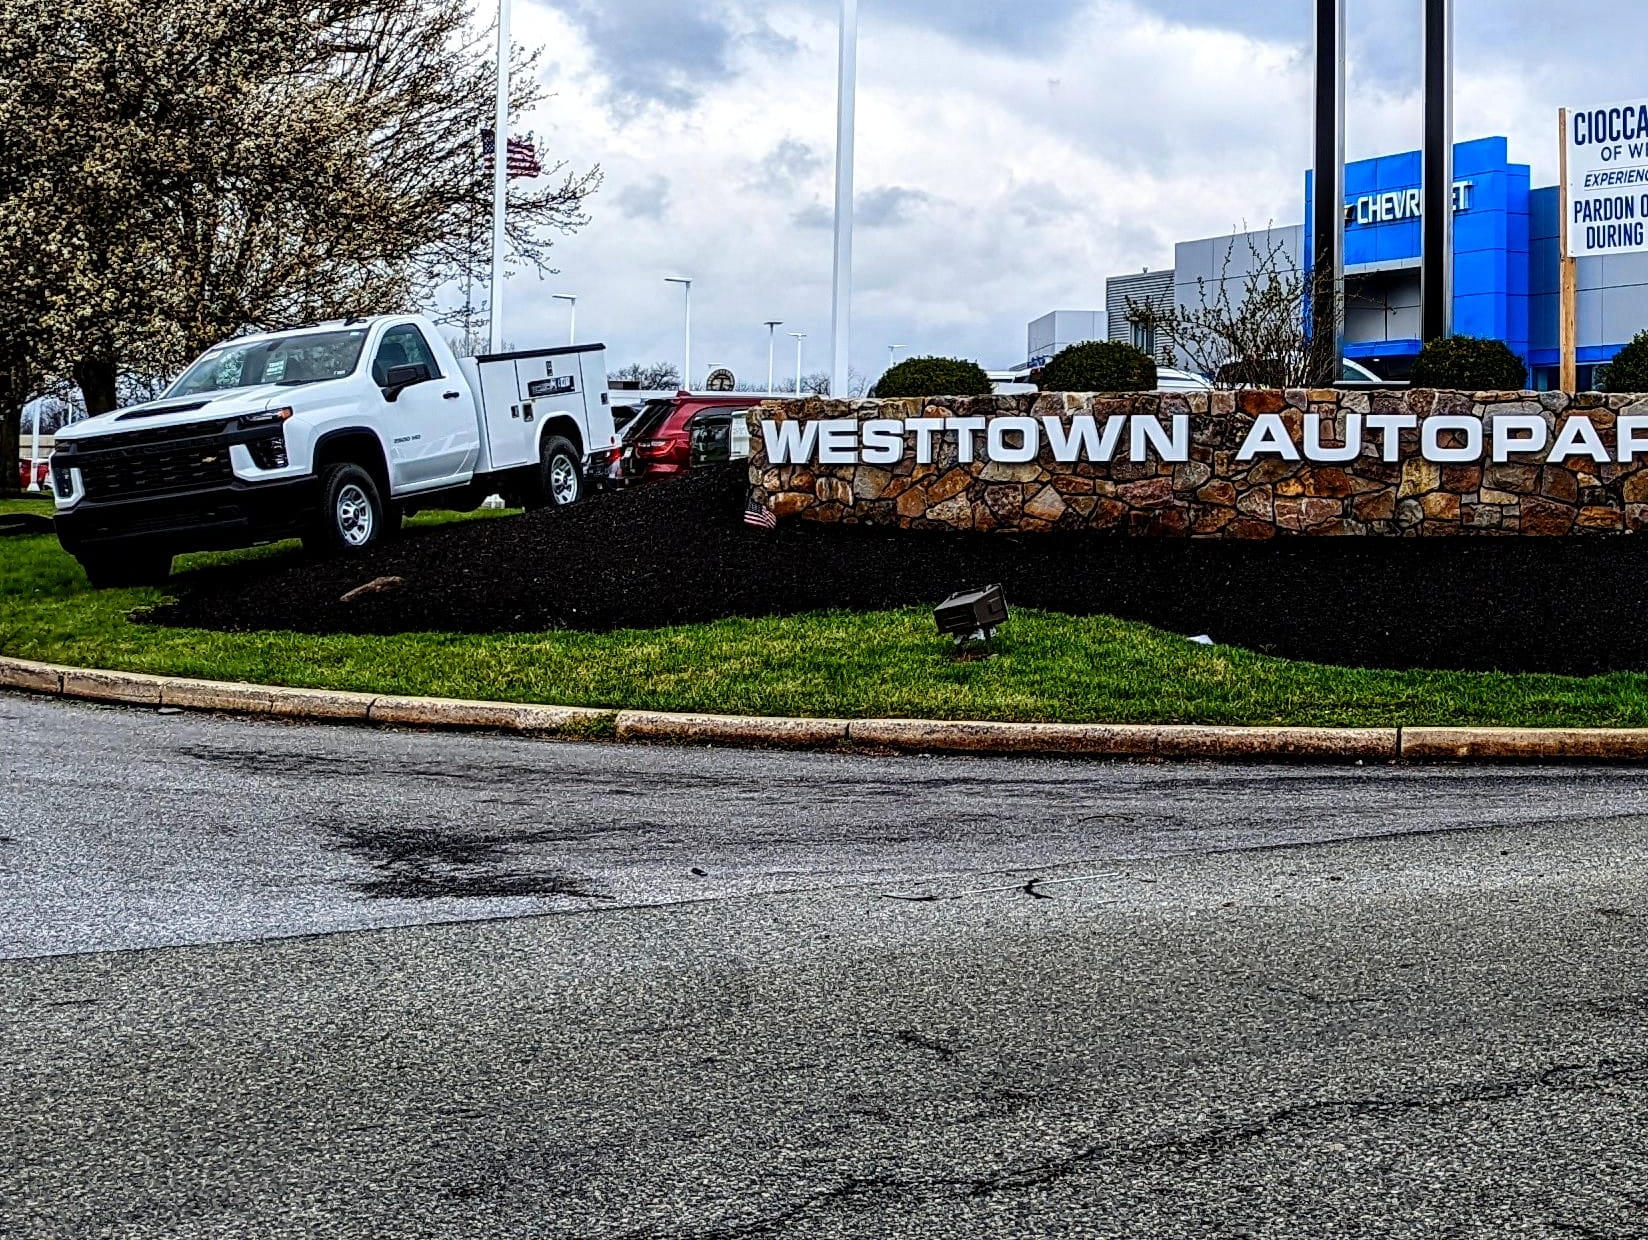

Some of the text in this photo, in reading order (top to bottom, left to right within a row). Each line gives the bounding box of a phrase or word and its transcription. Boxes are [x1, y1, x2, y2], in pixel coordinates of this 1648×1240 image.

[1600, 145, 1622, 162] OF
[1356, 180, 1472, 224] CHEVRT
[1573, 195, 1635, 224] PARDON
[1586, 222, 1644, 249] DURING
[761, 414, 1190, 464] WESTTOWN
